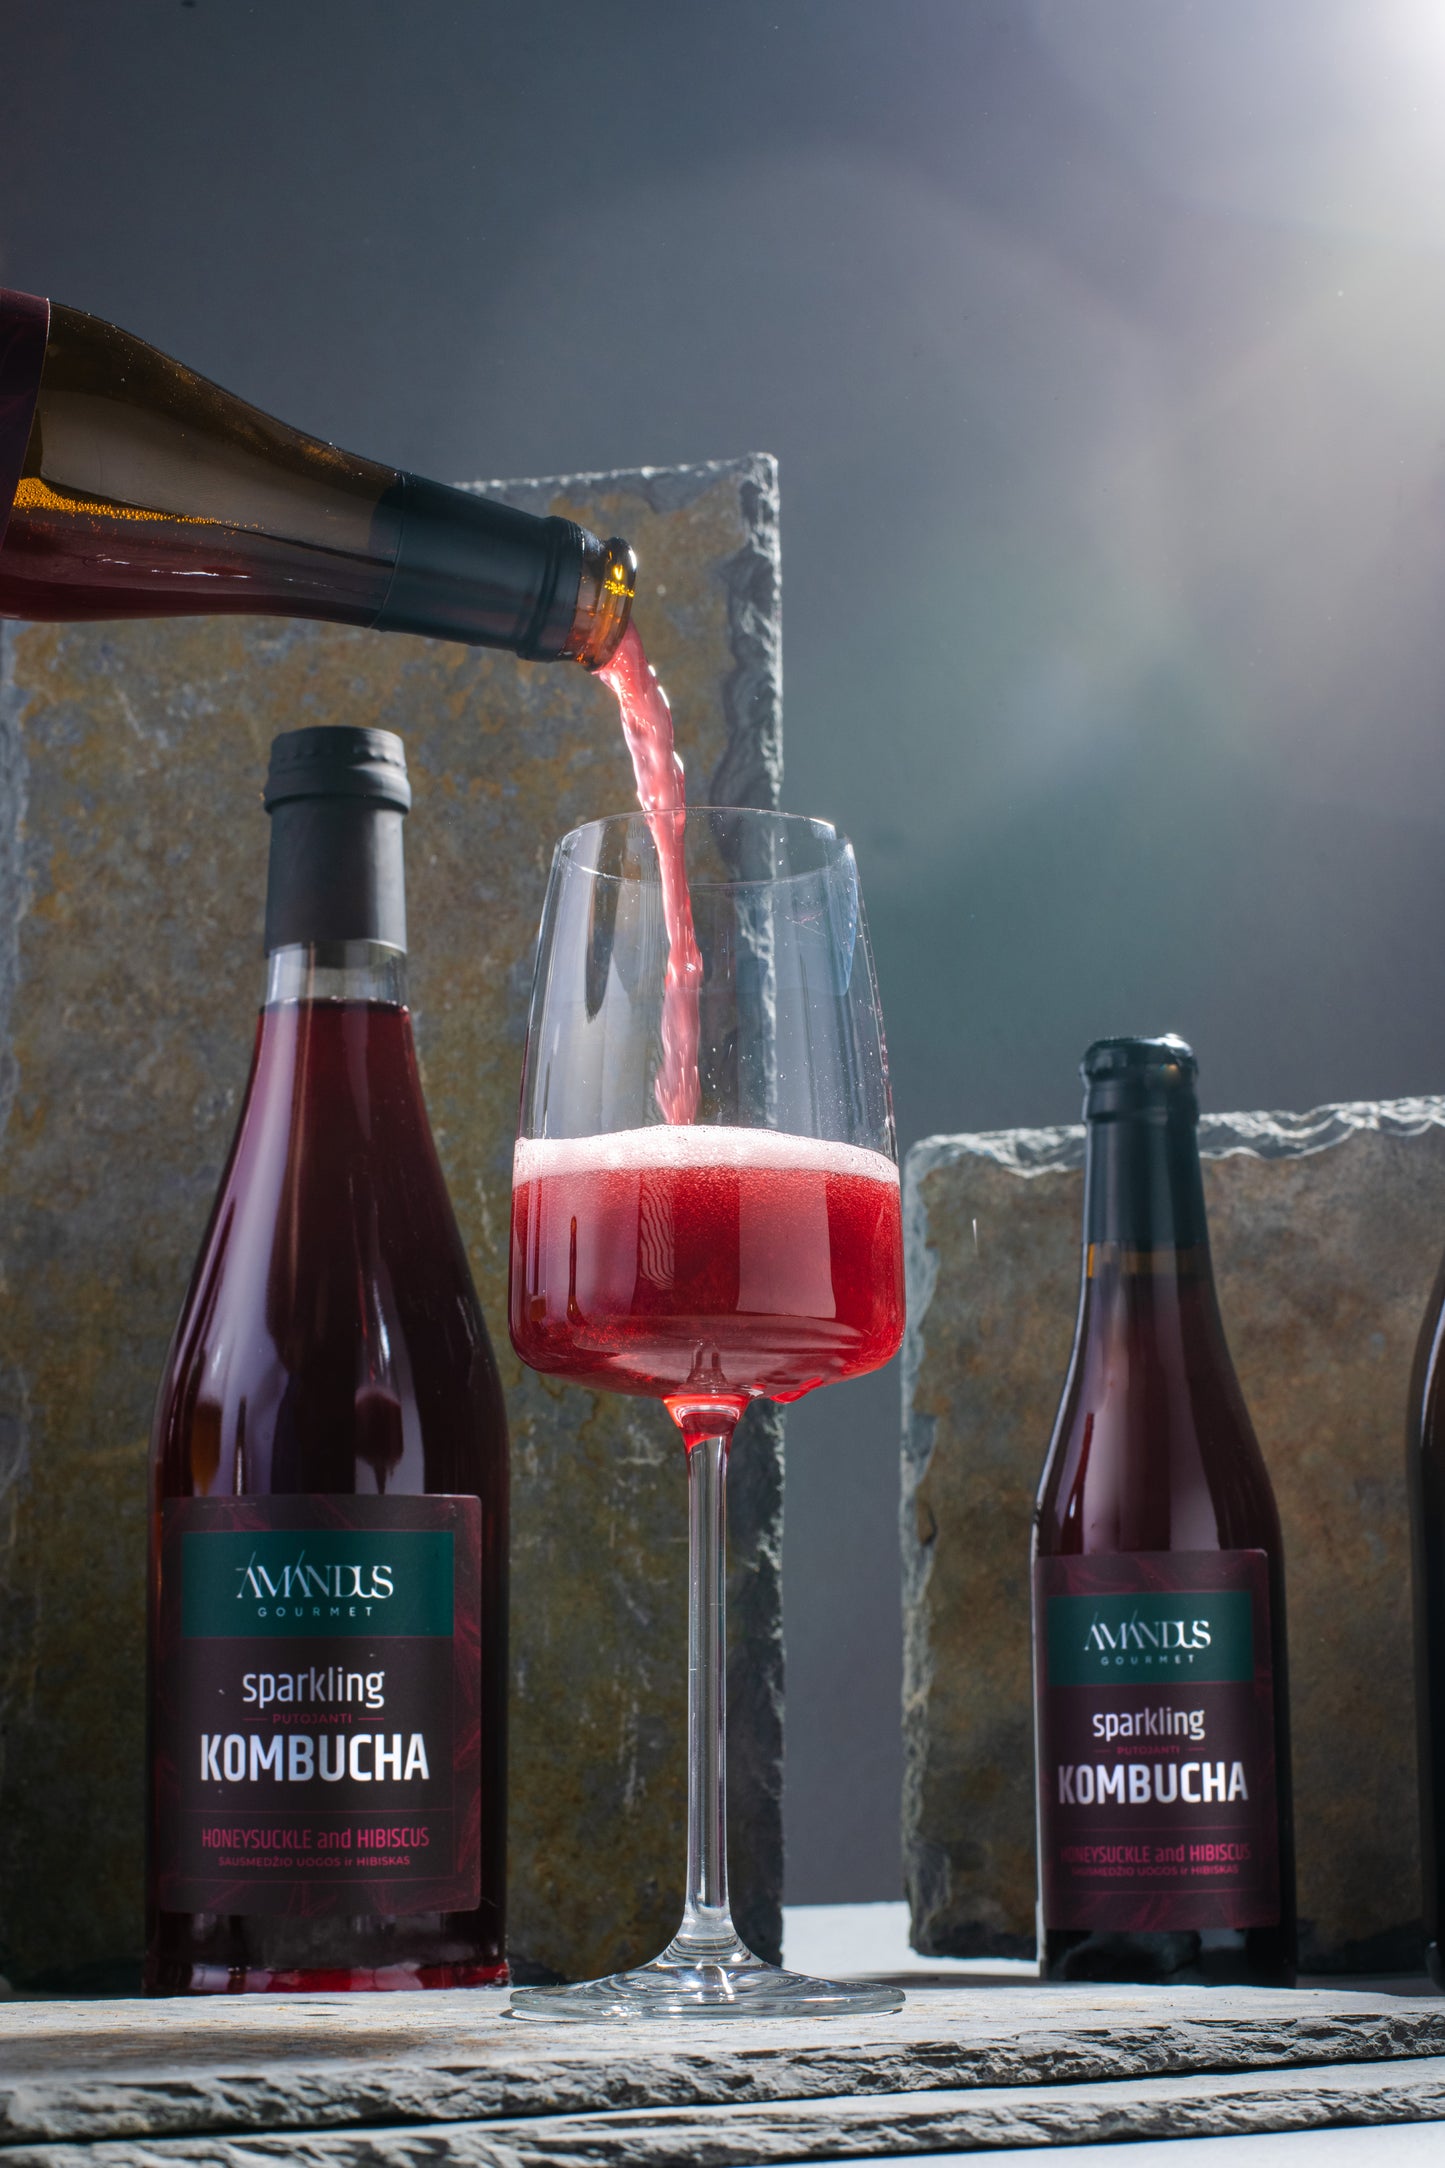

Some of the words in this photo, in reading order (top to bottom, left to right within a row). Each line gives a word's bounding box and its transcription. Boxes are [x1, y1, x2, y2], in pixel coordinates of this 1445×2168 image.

[257, 1606, 373, 1618] GOURMET
[1100, 1654, 1195, 1666] GOURMET
[242, 1666, 385, 1709] sparkling
[272, 1713, 352, 1725] PUTOJANTI
[1092, 1707, 1206, 1742] sparkling
[201, 1733, 430, 1782] KOMBUCHA
[1058, 1761, 1249, 1805] KOMBUCHA
[202, 1828, 313, 1849] HONEYSUCKLE
[317, 1828, 351, 1849] and
[357, 1827, 430, 1849] HIBISCUS
[356, 1855, 410, 1867] HIBISKAS
[1155, 1845, 1185, 1863] and
[1190, 1843, 1250, 1863] HIBISCUS
